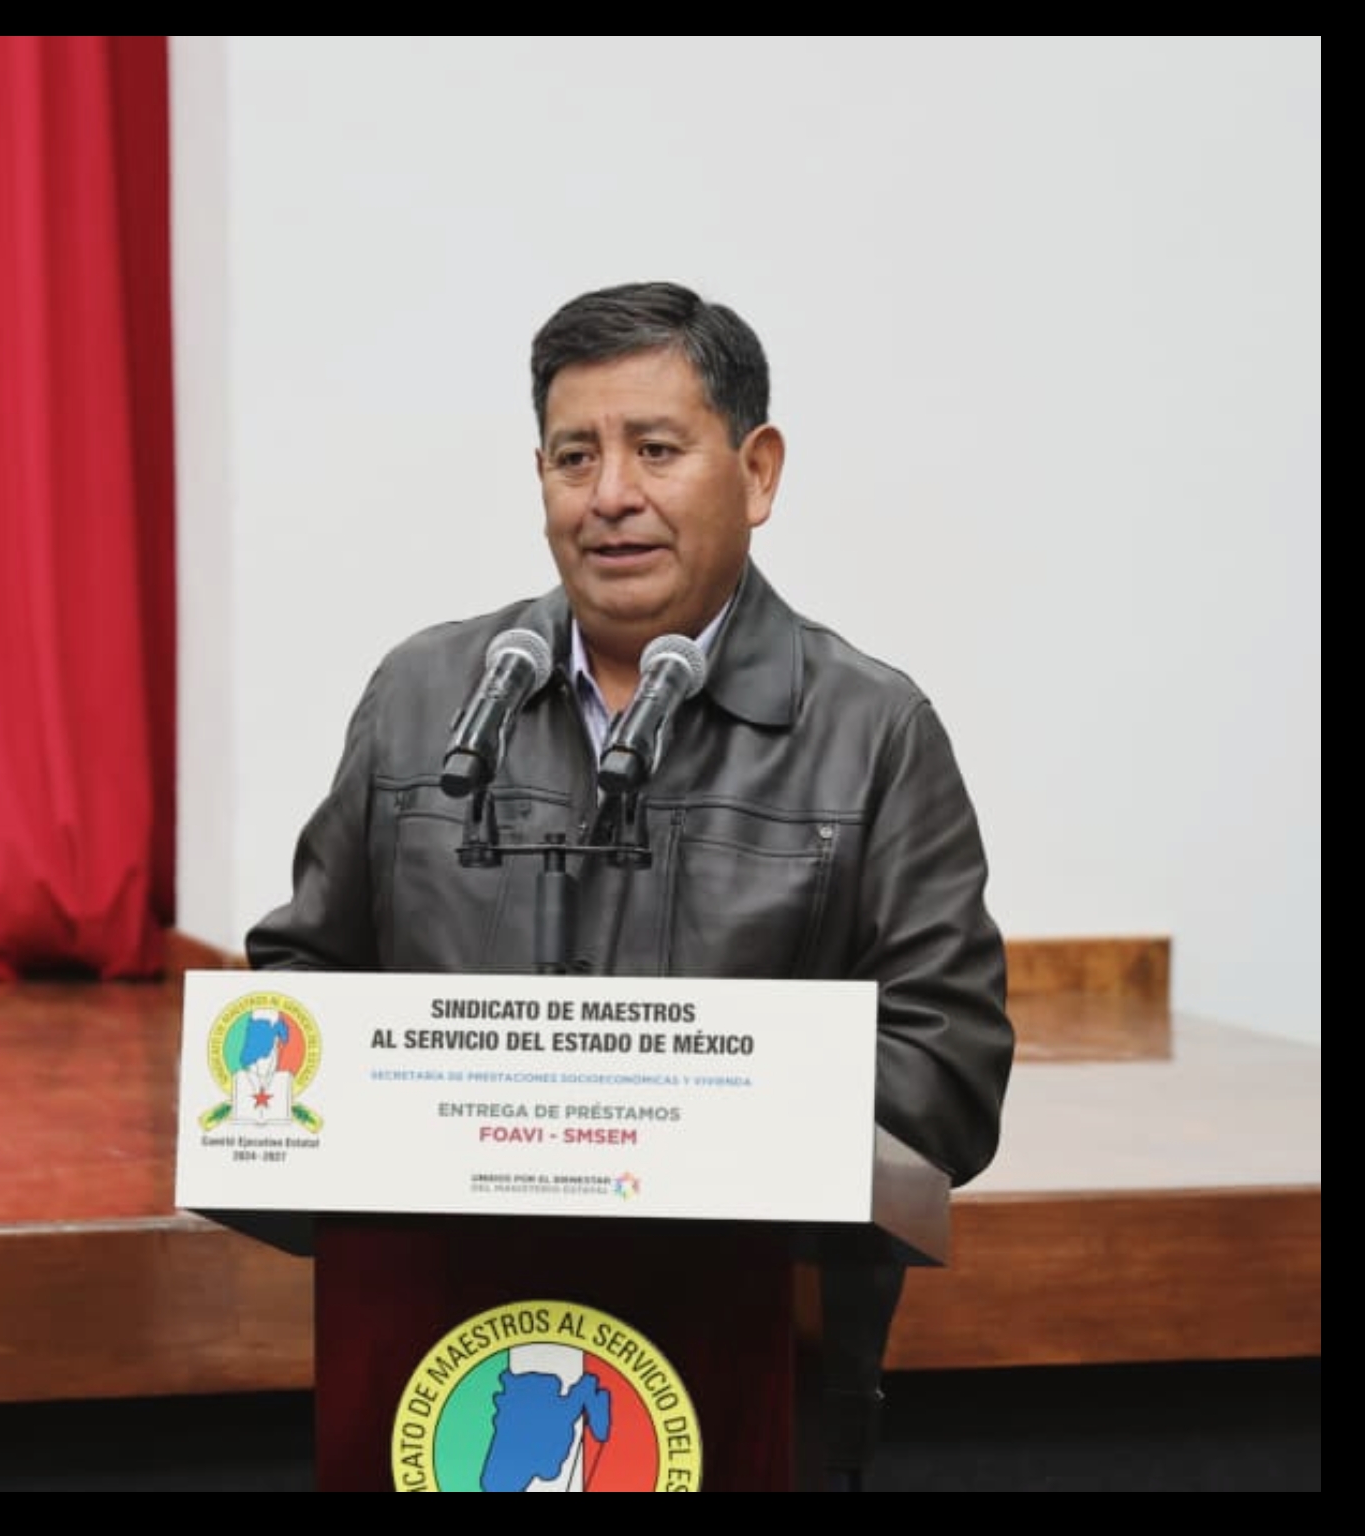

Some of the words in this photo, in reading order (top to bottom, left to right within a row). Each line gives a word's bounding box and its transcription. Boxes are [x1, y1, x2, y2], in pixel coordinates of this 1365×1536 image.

[431, 998, 541, 1021] SINDICATO
[547, 1000, 575, 1021] DE
[581, 1001, 696, 1023] MAESTROS
[371, 1029, 397, 1049] AL
[403, 1030, 500, 1051] SERVICIO
[506, 1031, 545, 1051] DEL
[552, 1032, 632, 1053] ESTADO
[638, 1033, 666, 1054] DE
[672, 1029, 755, 1055] MÉXICO
[438, 1102, 529, 1119] ENTREGA
[534, 1104, 560, 1120] DE
[565, 1101, 681, 1122] PRÉSTAMOS
[479, 1126, 544, 1143] FOAVI
[563, 1127, 637, 1145] SMSEM
[409, 1384, 437, 1416] DE
[429, 1309, 550, 1386] MAESTROS
[557, 1312, 587, 1340] AL
[592, 1323, 679, 1411] SERVICIO
[663, 1416, 691, 1460] DEL
